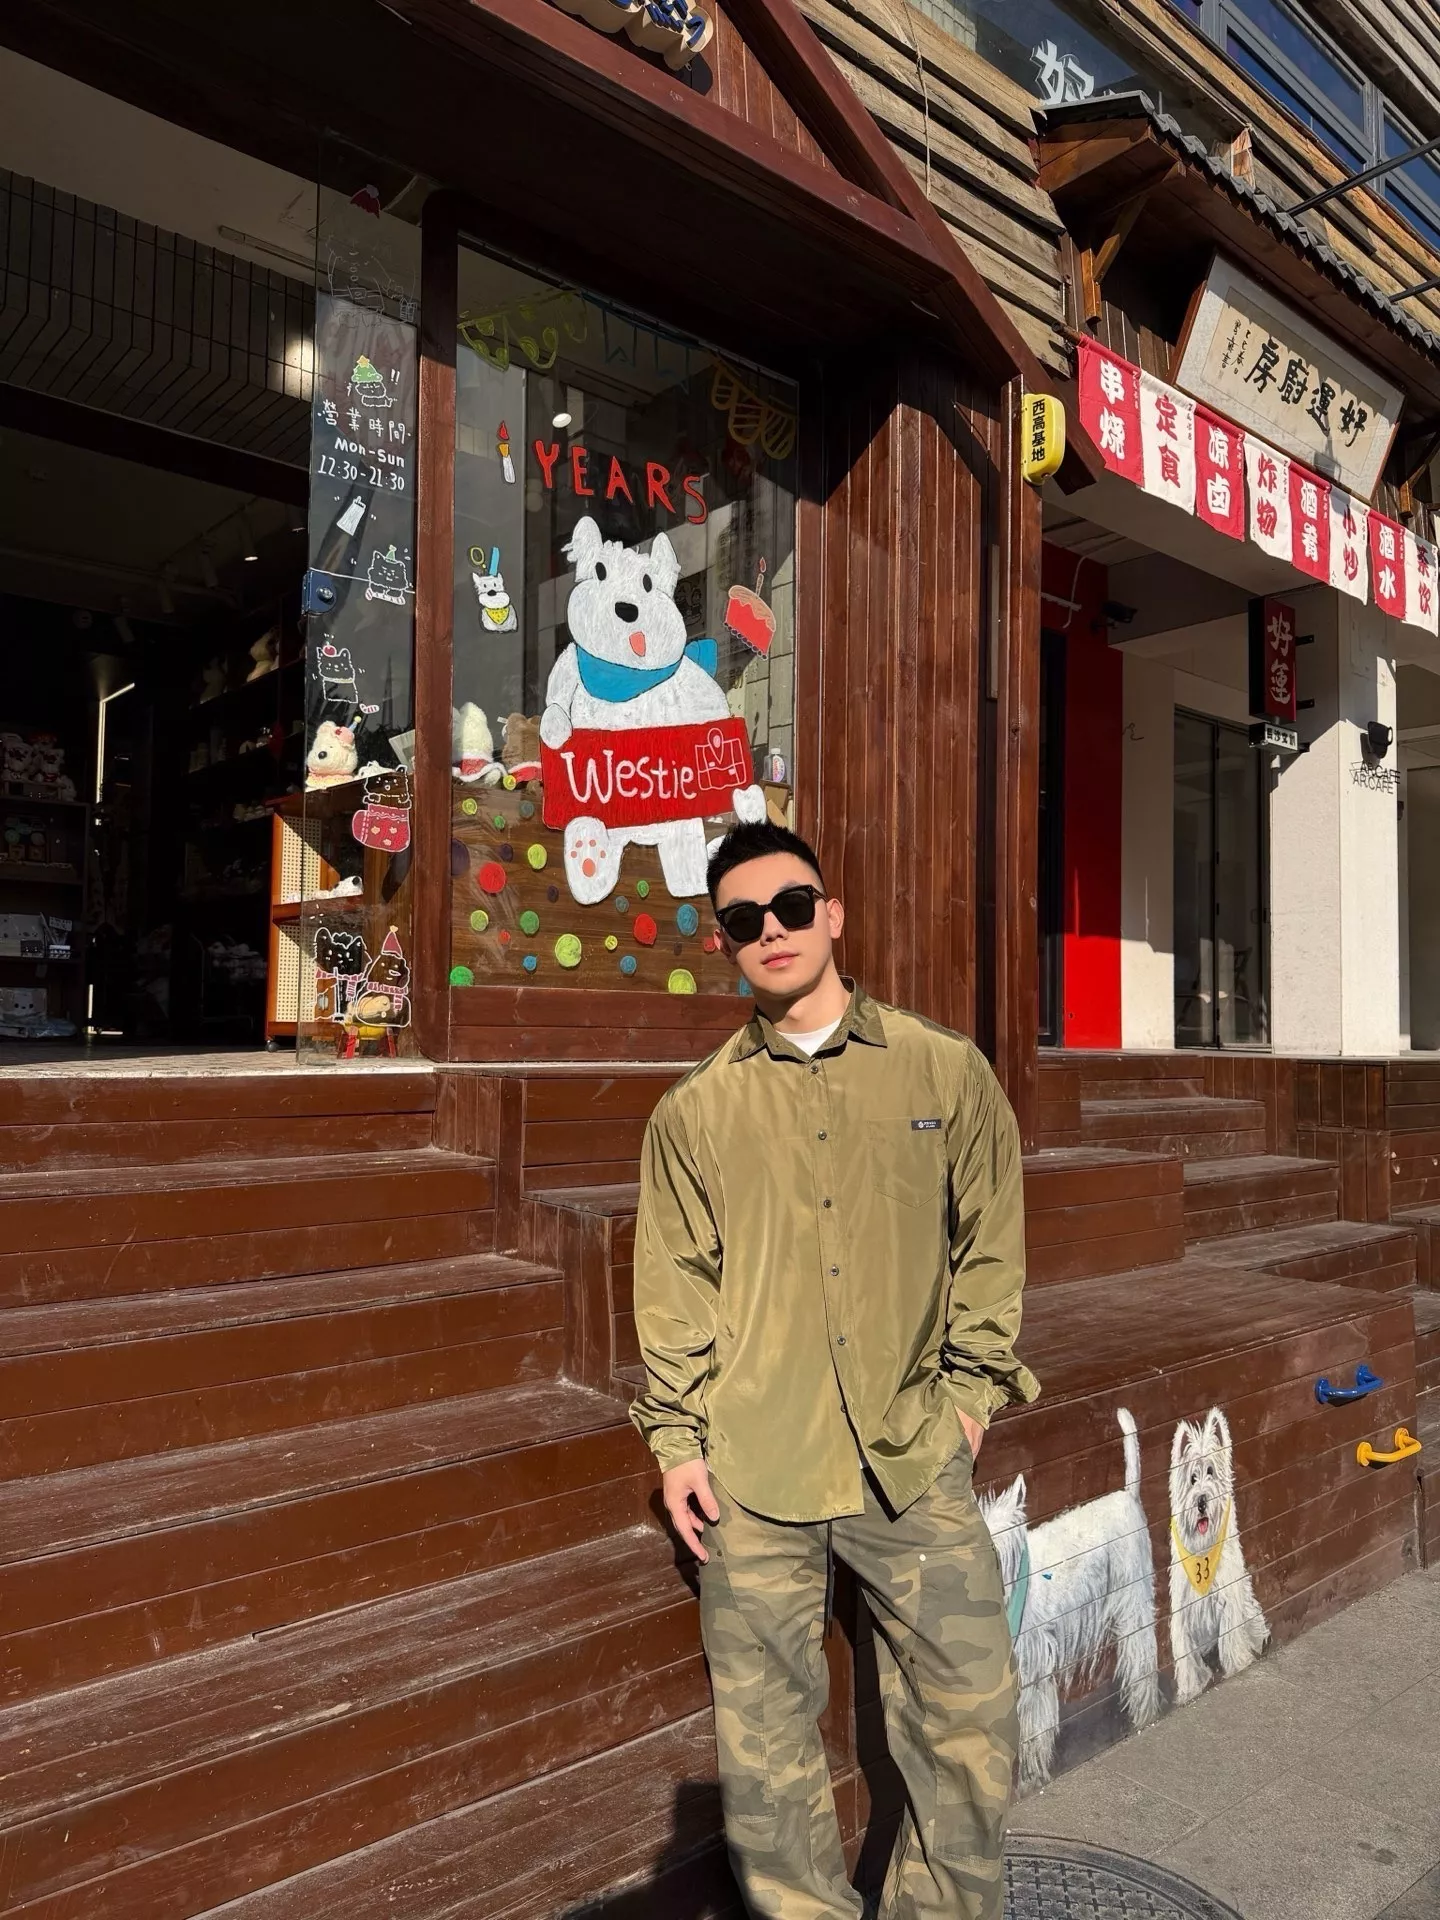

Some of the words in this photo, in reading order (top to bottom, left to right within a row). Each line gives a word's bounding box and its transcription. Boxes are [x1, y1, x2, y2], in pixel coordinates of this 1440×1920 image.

[1031, 398, 1046, 462] 西高基地
[1099, 358, 1126, 461] 串烧
[1155, 393, 1182, 489] 定食
[534, 439, 709, 525] YEARS
[1256, 452, 1279, 540] 炸物
[1342, 504, 1359, 582] 小炒
[1378, 522, 1396, 600] 酒水
[1416, 543, 1432, 617] 茶饮
[1266, 611, 1293, 705] 好運
[560, 749, 698, 805] Westie
[1195, 1556, 1210, 1584] 33
